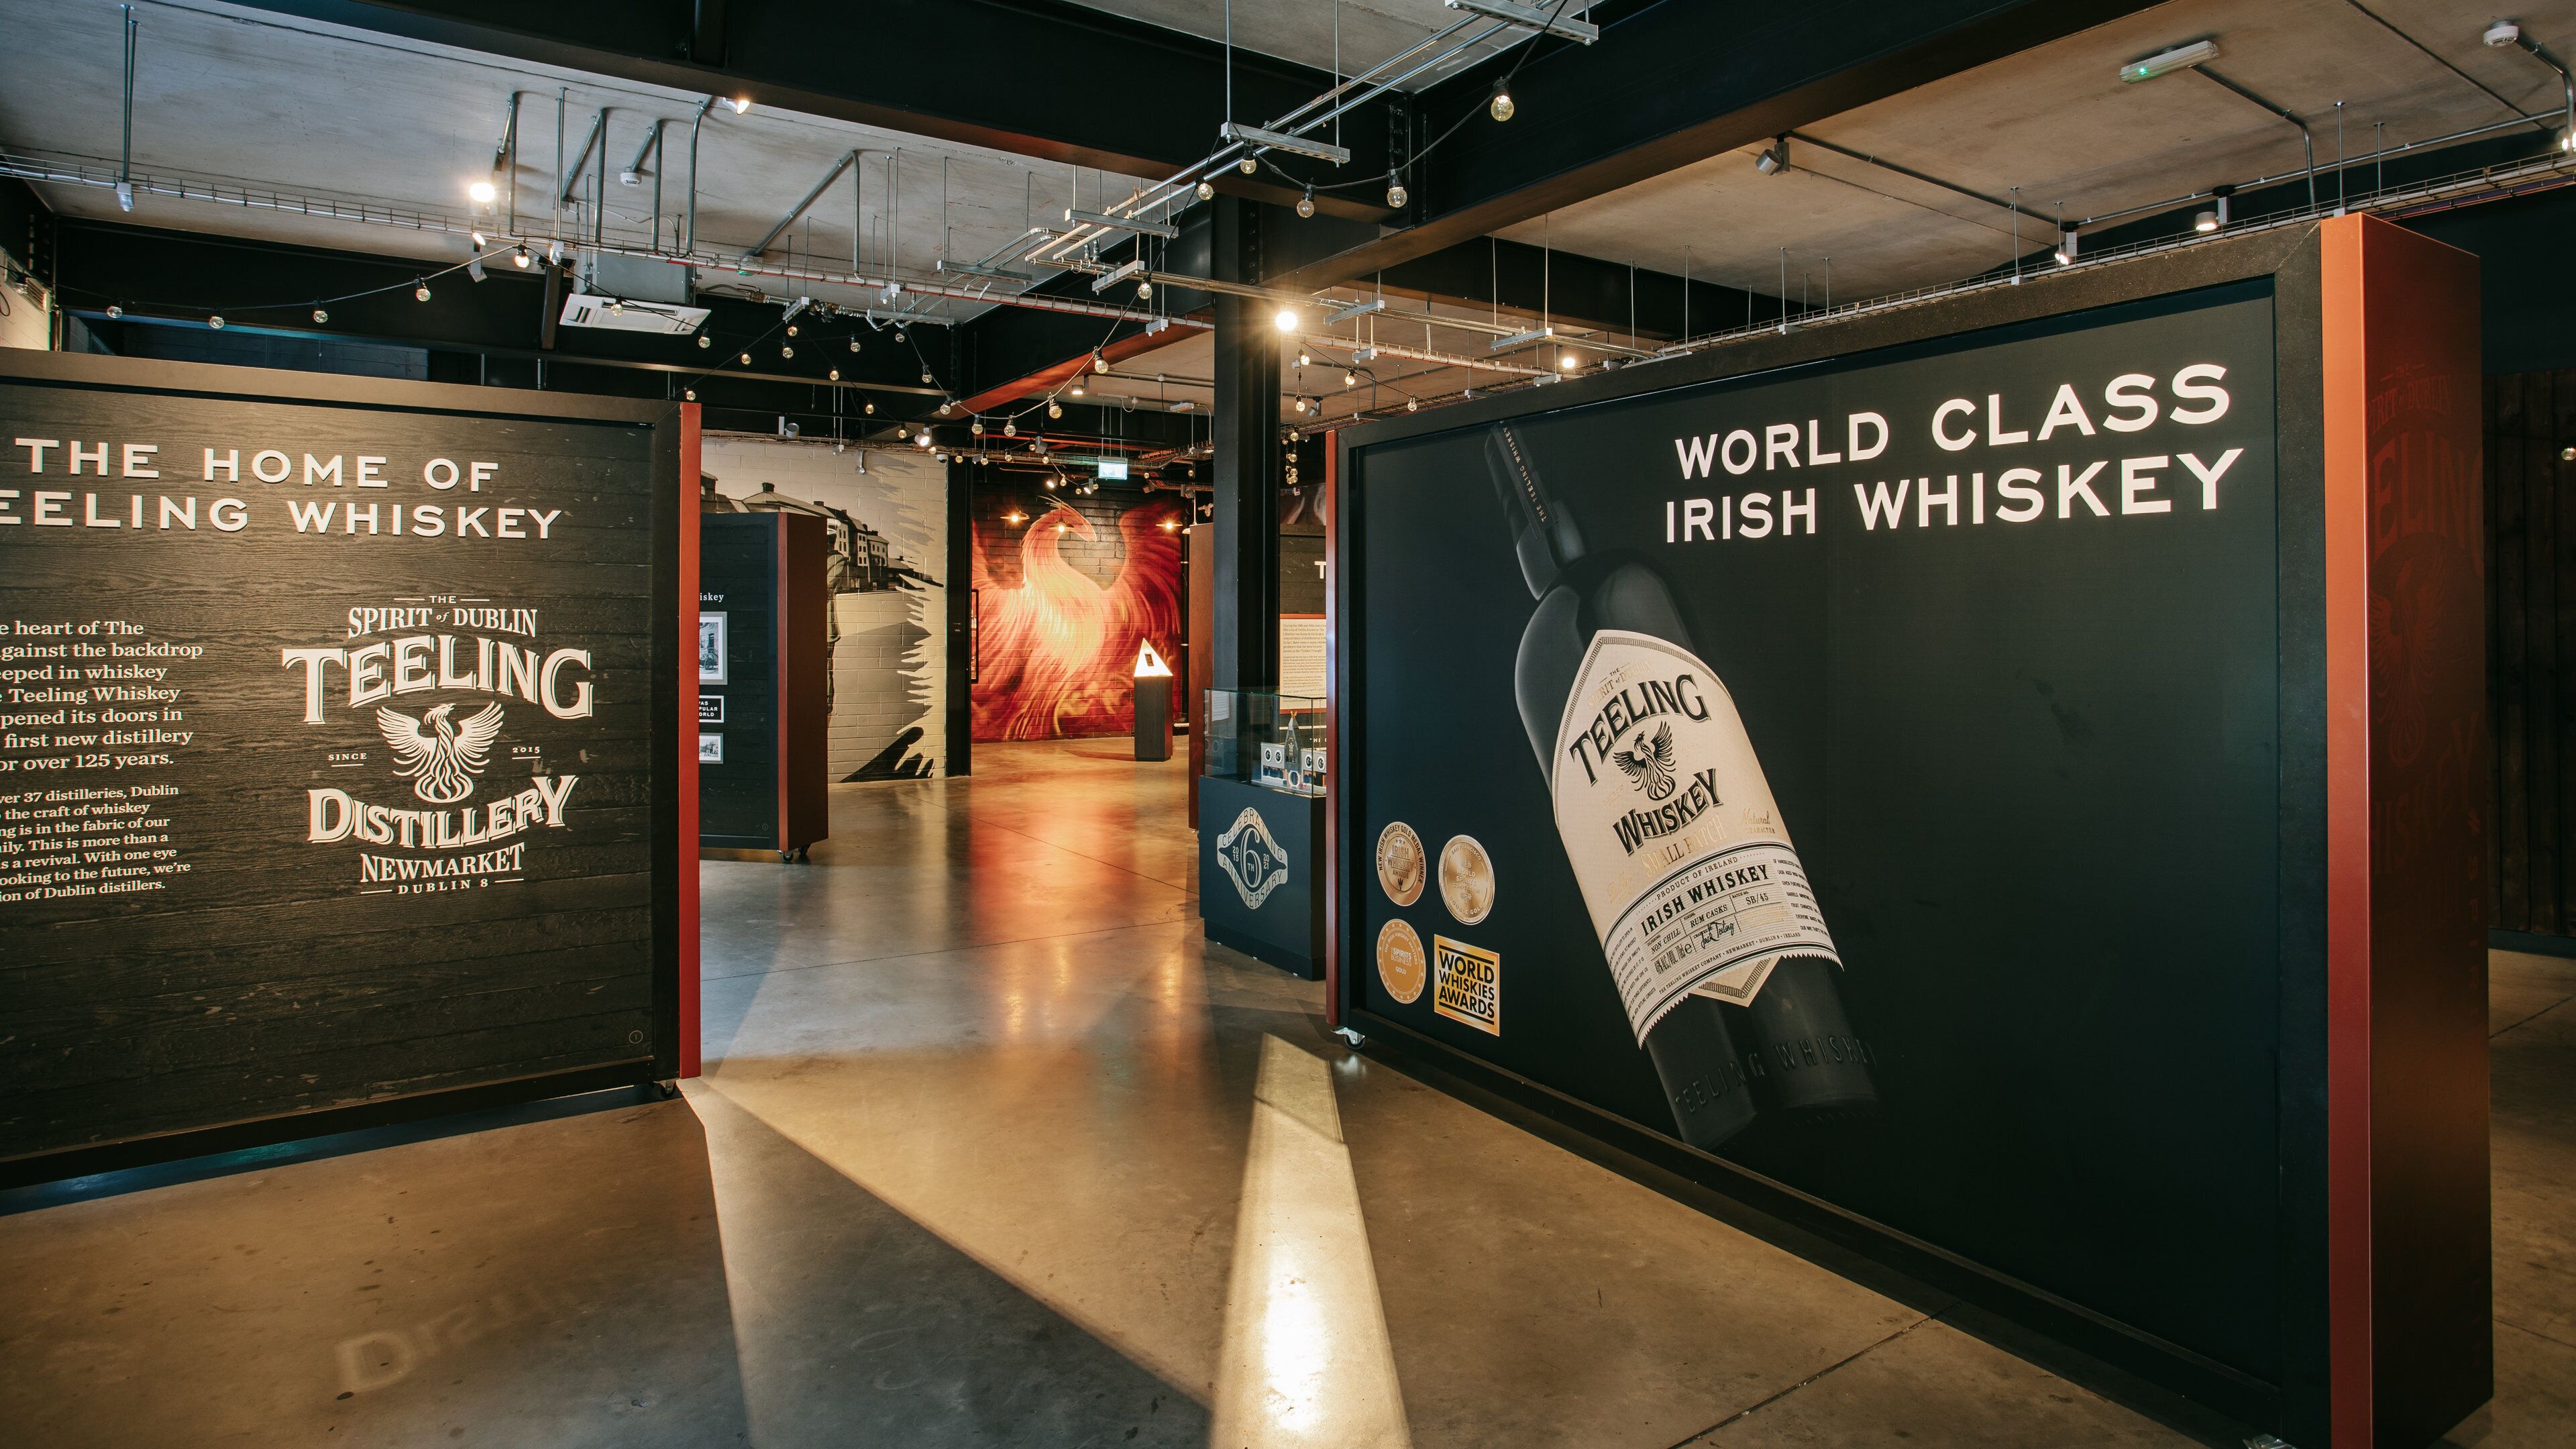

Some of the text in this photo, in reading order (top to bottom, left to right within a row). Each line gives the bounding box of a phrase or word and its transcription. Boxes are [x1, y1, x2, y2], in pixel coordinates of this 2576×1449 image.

[1676, 364, 2230, 480] WORLD CLASS
[1503, 427, 1521, 463] WHISKEY
[15, 438, 499, 492] THE HOME OF
[1519, 466, 1537, 502] TEELING
[1667, 449, 2243, 543] IRISH WHISKEY
[287, 500, 562, 539] WHISKEY
[429, 596, 457, 604] THE
[15, 621, 73, 635] heart
[78, 621, 101, 635] of
[104, 621, 144, 635] The
[348, 606, 537, 639] SPIRIT of DUBLIN
[72, 642, 203, 659] the backdrop
[59, 664, 168, 681] in whiskey
[282, 635, 594, 724] TEELING
[1610, 668, 1619, 676] THE
[8, 686, 180, 704] Teeling Whiskey
[70, 709, 96, 724] its
[101, 708, 158, 722] doors
[163, 708, 182, 721] in
[4, 729, 194, 749] first new distillery
[1569, 674, 1711, 786] TEELING
[23, 758, 70, 770] over
[75, 754, 110, 768] 125
[115, 753, 174, 770] years.
[328, 753, 368, 761] SINCE
[513, 746, 541, 754] 2015
[23, 792, 42, 803] 37
[46, 788, 127, 802] distilleries,
[131, 785, 179, 797] Dublin
[5, 802, 150, 820] the craft of whiskey
[307, 774, 580, 849] DISTILLERY
[1612, 768, 1723, 857] WHISKEY
[19, 824, 32, 835] is
[36, 823, 52, 834] in
[55, 822, 80, 833] the
[83, 818, 125, 832] fabric
[127, 817, 144, 828] of
[145, 818, 170, 827] our
[1222, 809, 1283, 861] CELEBRATING
[29, 834, 169, 851] This is more than a
[1383, 824, 1400, 839] WHISKEY
[1401, 825, 1411, 837] GOLD
[1411, 835, 1422, 855] MEDAL
[12, 849, 177, 869] a revival. With one eye
[360, 842, 525, 883] NEWMARKET
[54, 871, 70, 881] to
[73, 869, 99, 880] the
[101, 866, 151, 878] future,
[1222, 857, 1283, 908] ANNIVERSARY
[1657, 857, 1738, 900] PRODUCT OF IRELAND
[25, 888, 42, 900] of
[44, 885, 95, 898] Dublin
[99, 880, 166, 894] distillers.
[398, 879, 488, 895] DUBLIN 8
[1746, 893, 1769, 905] SB/45
[1641, 864, 1770, 936] IRISH WHISKEY
[1690, 915, 1705, 928] RUM
[1707, 904, 1728, 919] CASKS
[1652, 943, 1662, 954] NON
[1663, 928, 1681, 944] CHILL
[1393, 948, 1411, 960] SPIRITS
[1666, 976, 1682, 987] TEELING
[1682, 965, 1700, 977] WHISKEY
[1701, 953, 1721, 966] COMPANY
[1725, 941, 1755, 955] NEWMARKET
[1759, 935, 1776, 943] DUBLIN
[1395, 966, 1406, 975] GOLD
[1439, 950, 1495, 984] WORLD
[1439, 969, 1495, 1001] WHISKIES
[1439, 988, 1495, 1018] AWARDS
